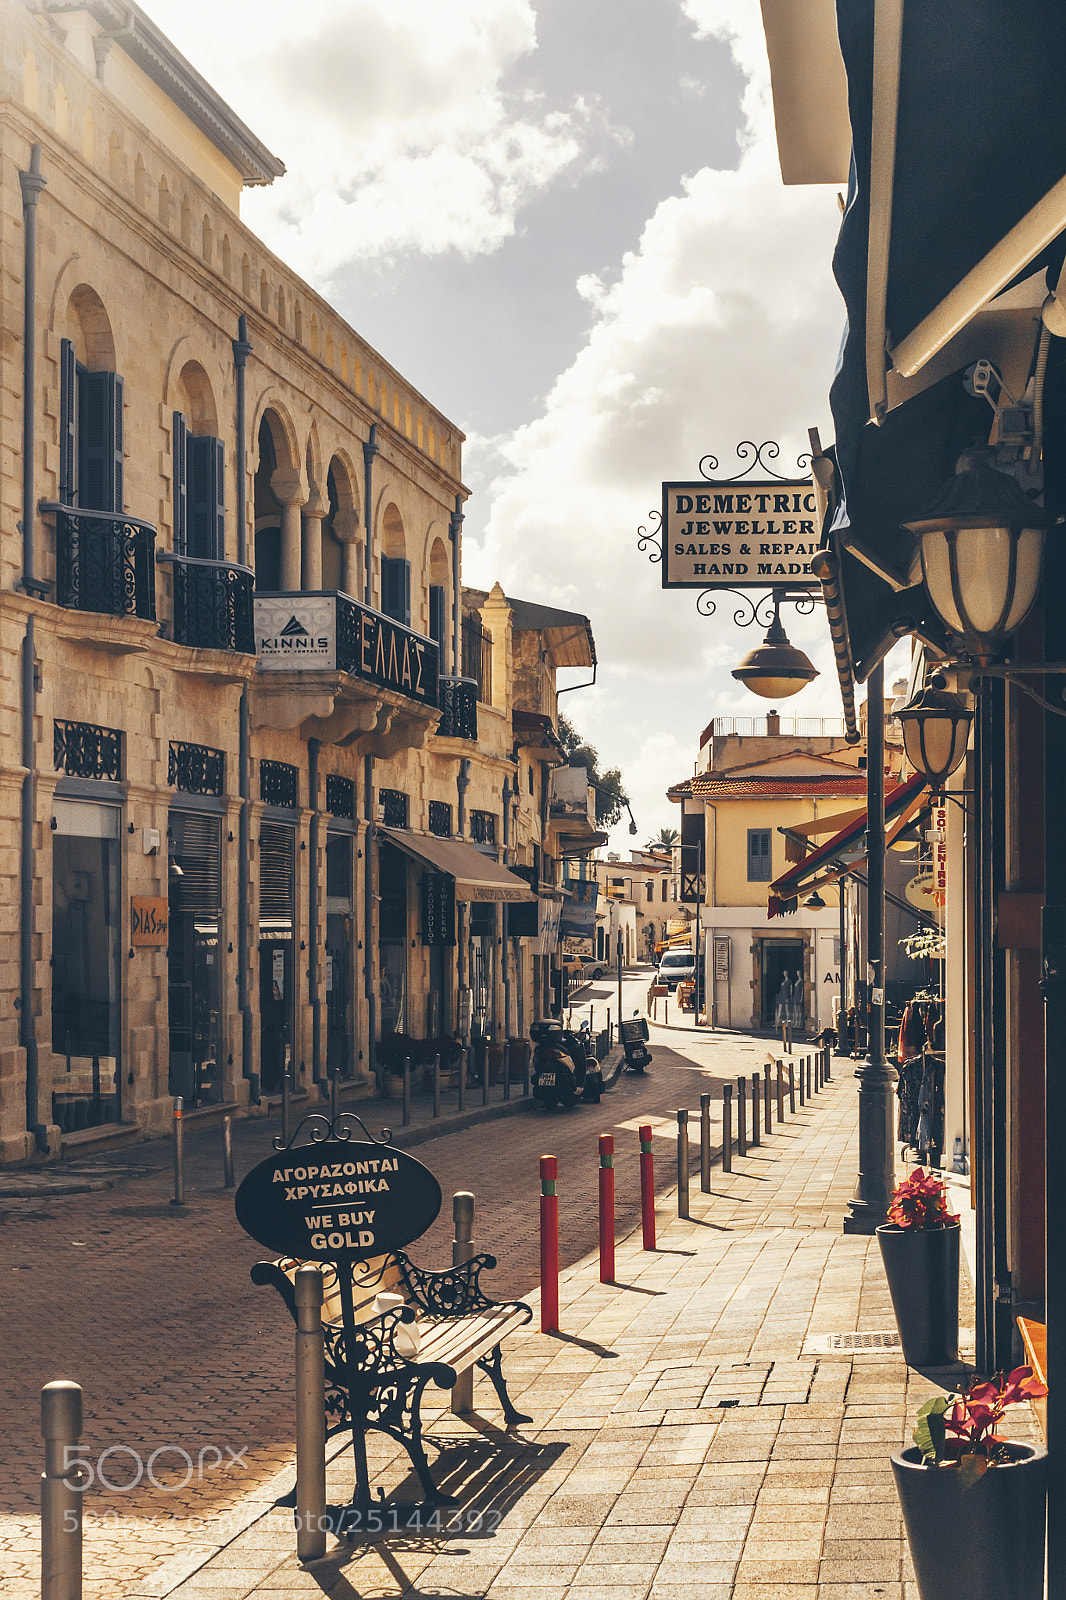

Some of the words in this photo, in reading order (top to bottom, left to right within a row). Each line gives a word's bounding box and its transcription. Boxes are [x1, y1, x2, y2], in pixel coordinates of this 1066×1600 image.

[681, 520, 815, 536] JEWELLER
[674, 543, 732, 556] SALES
[739, 543, 751, 556] &
[693, 563, 749, 575] HAND
[757, 563, 814, 575] MADE
[261, 638, 328, 649] KINNIS
[440, 881, 448, 939] JEWELLERY
[132, 907, 156, 935] DIAS
[272, 1158, 399, 1183] ΑΓΟΡΑΖΟΝΤΑΙ
[284, 1178, 390, 1201] ΧΡΥΣΑΦΙΚΑ
[304, 1214, 334, 1230] WE
[338, 1210, 376, 1227] BUY
[310, 1230, 375, 1250] GOLD
